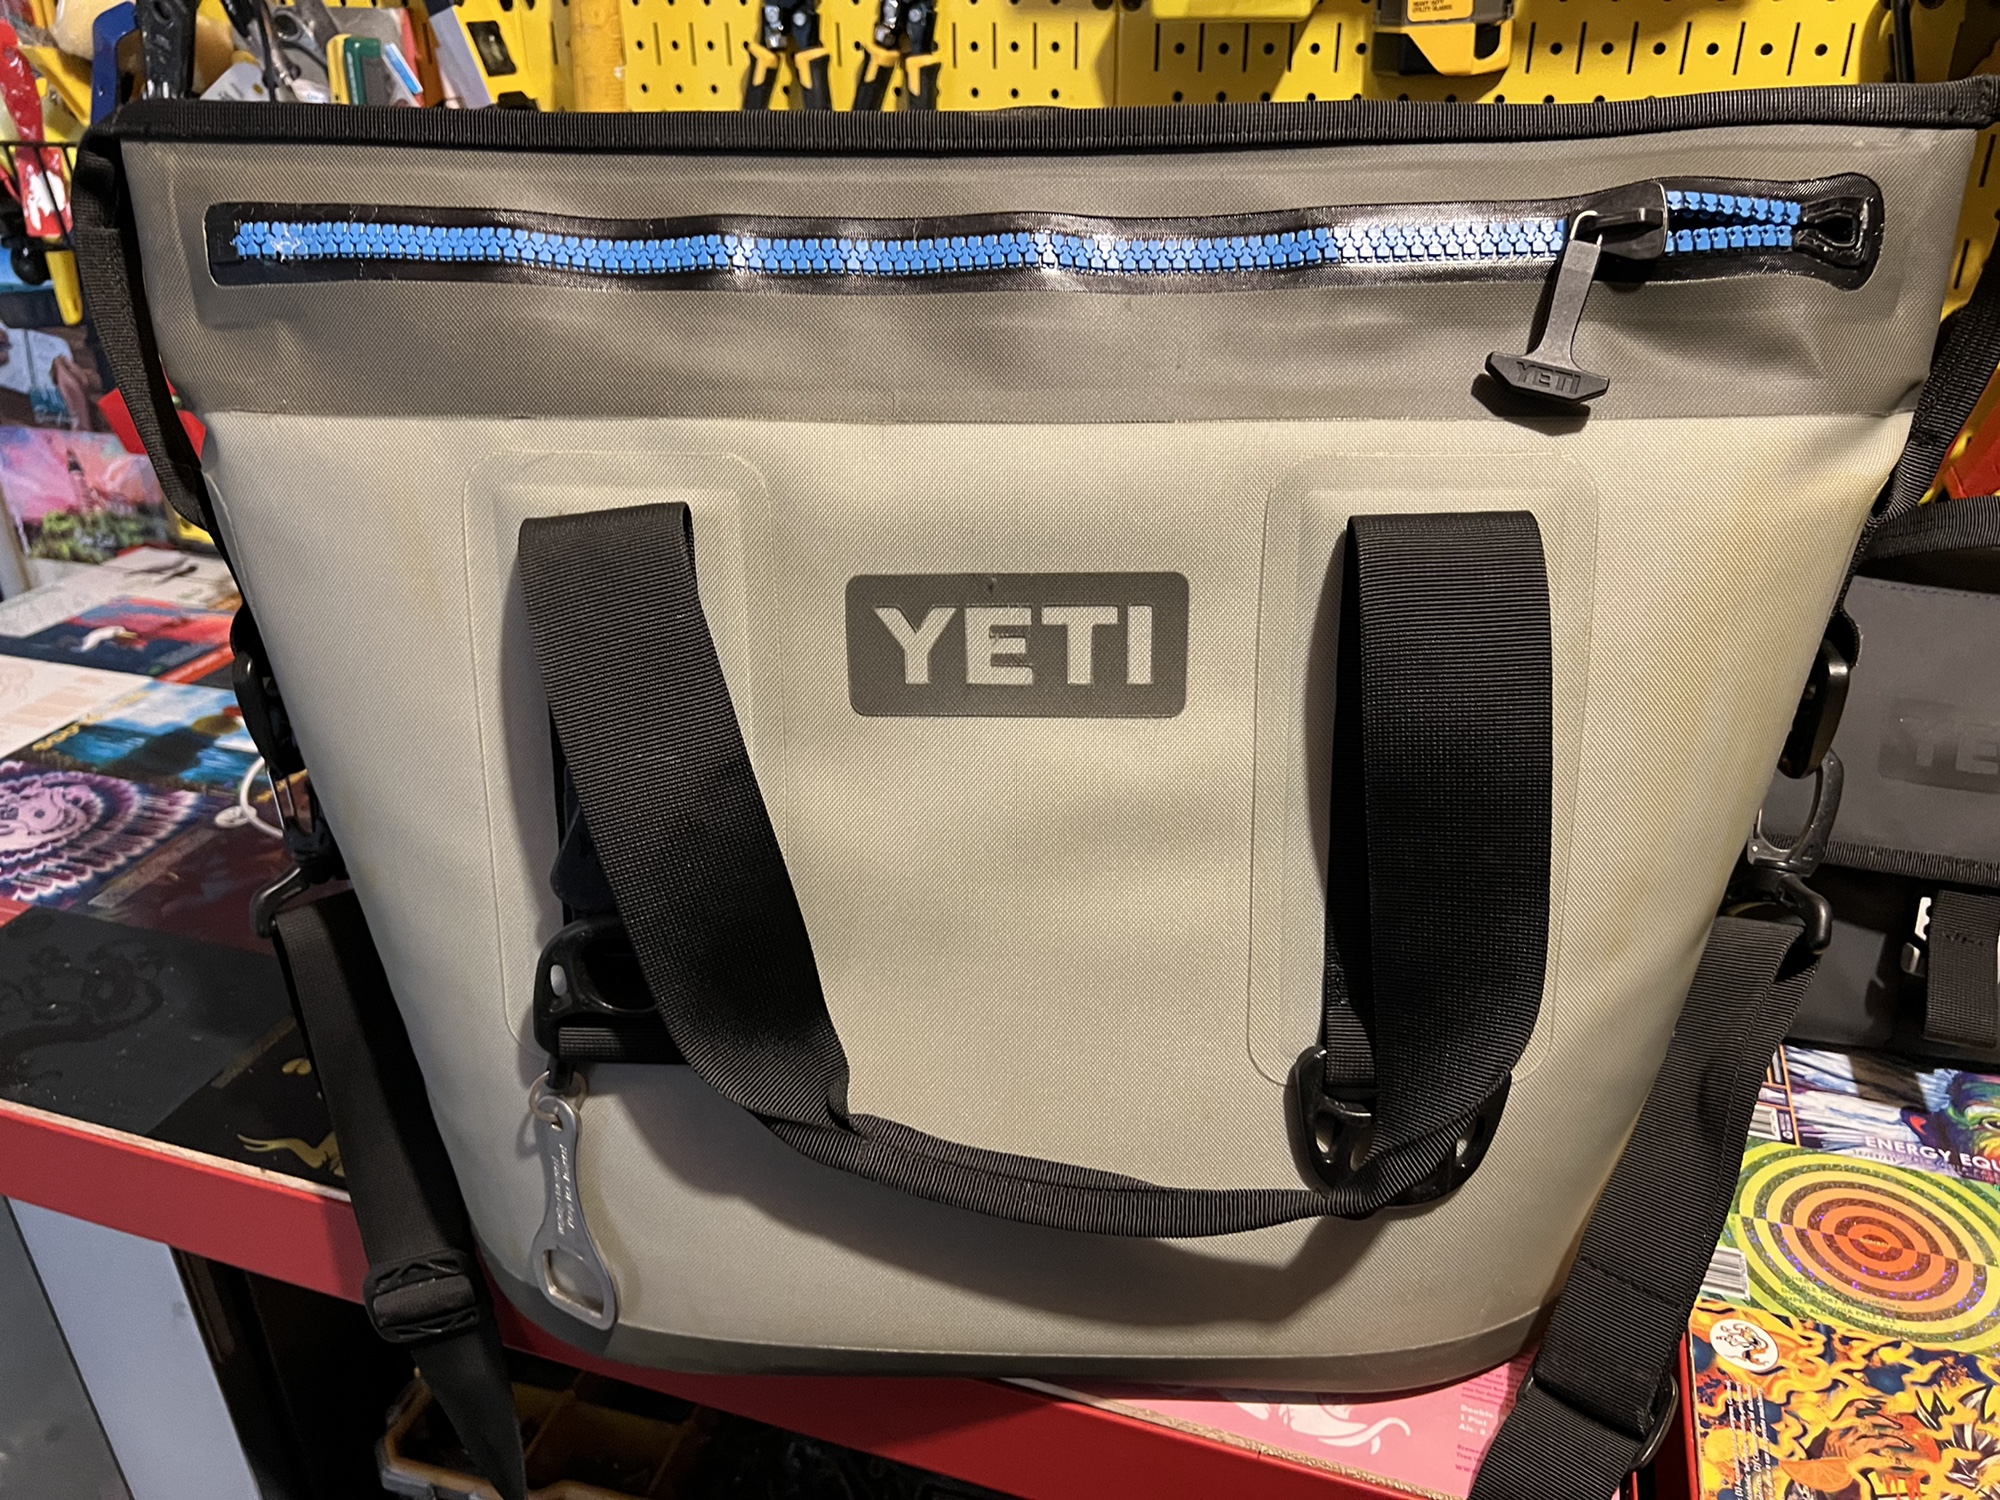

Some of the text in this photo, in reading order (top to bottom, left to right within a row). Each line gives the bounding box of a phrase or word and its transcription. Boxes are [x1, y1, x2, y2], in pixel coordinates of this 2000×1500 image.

[1516, 361, 1581, 395] YETI
[873, 604, 1153, 686] YETI
[1864, 1135, 1951, 1162] ENERGY
